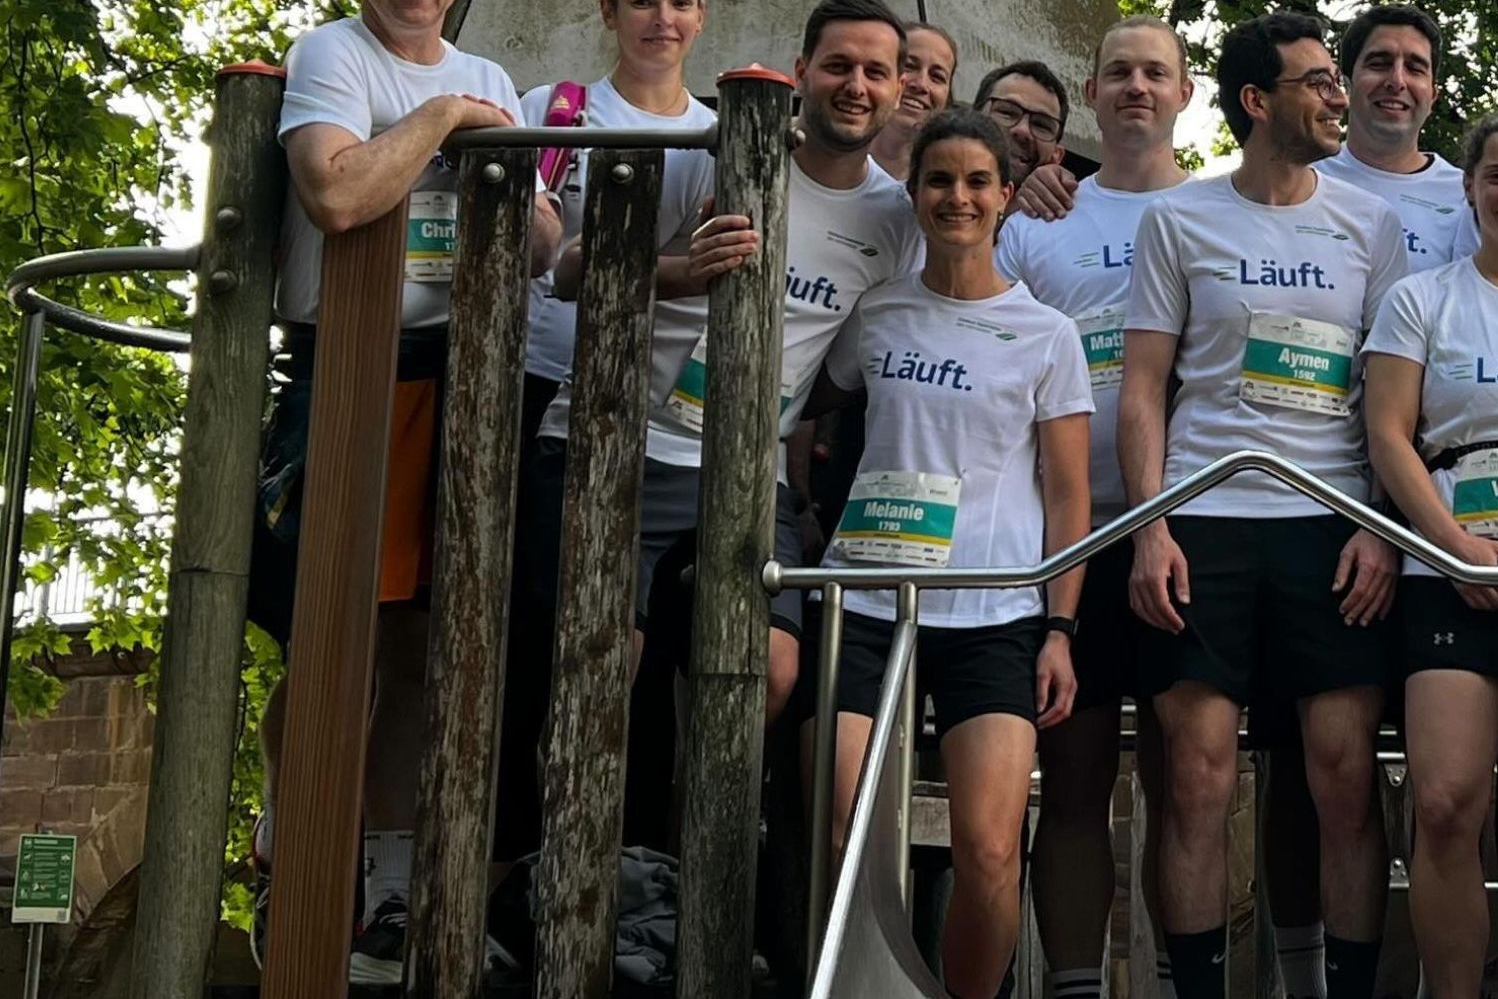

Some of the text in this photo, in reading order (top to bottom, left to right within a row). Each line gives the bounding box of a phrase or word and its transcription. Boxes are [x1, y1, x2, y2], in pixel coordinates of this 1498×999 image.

[1240, 259, 1335, 290] Läuft.
[881, 351, 972, 391] Läuft.
[1278, 347, 1330, 371] Aymen
[863, 501, 924, 521] Melanie
